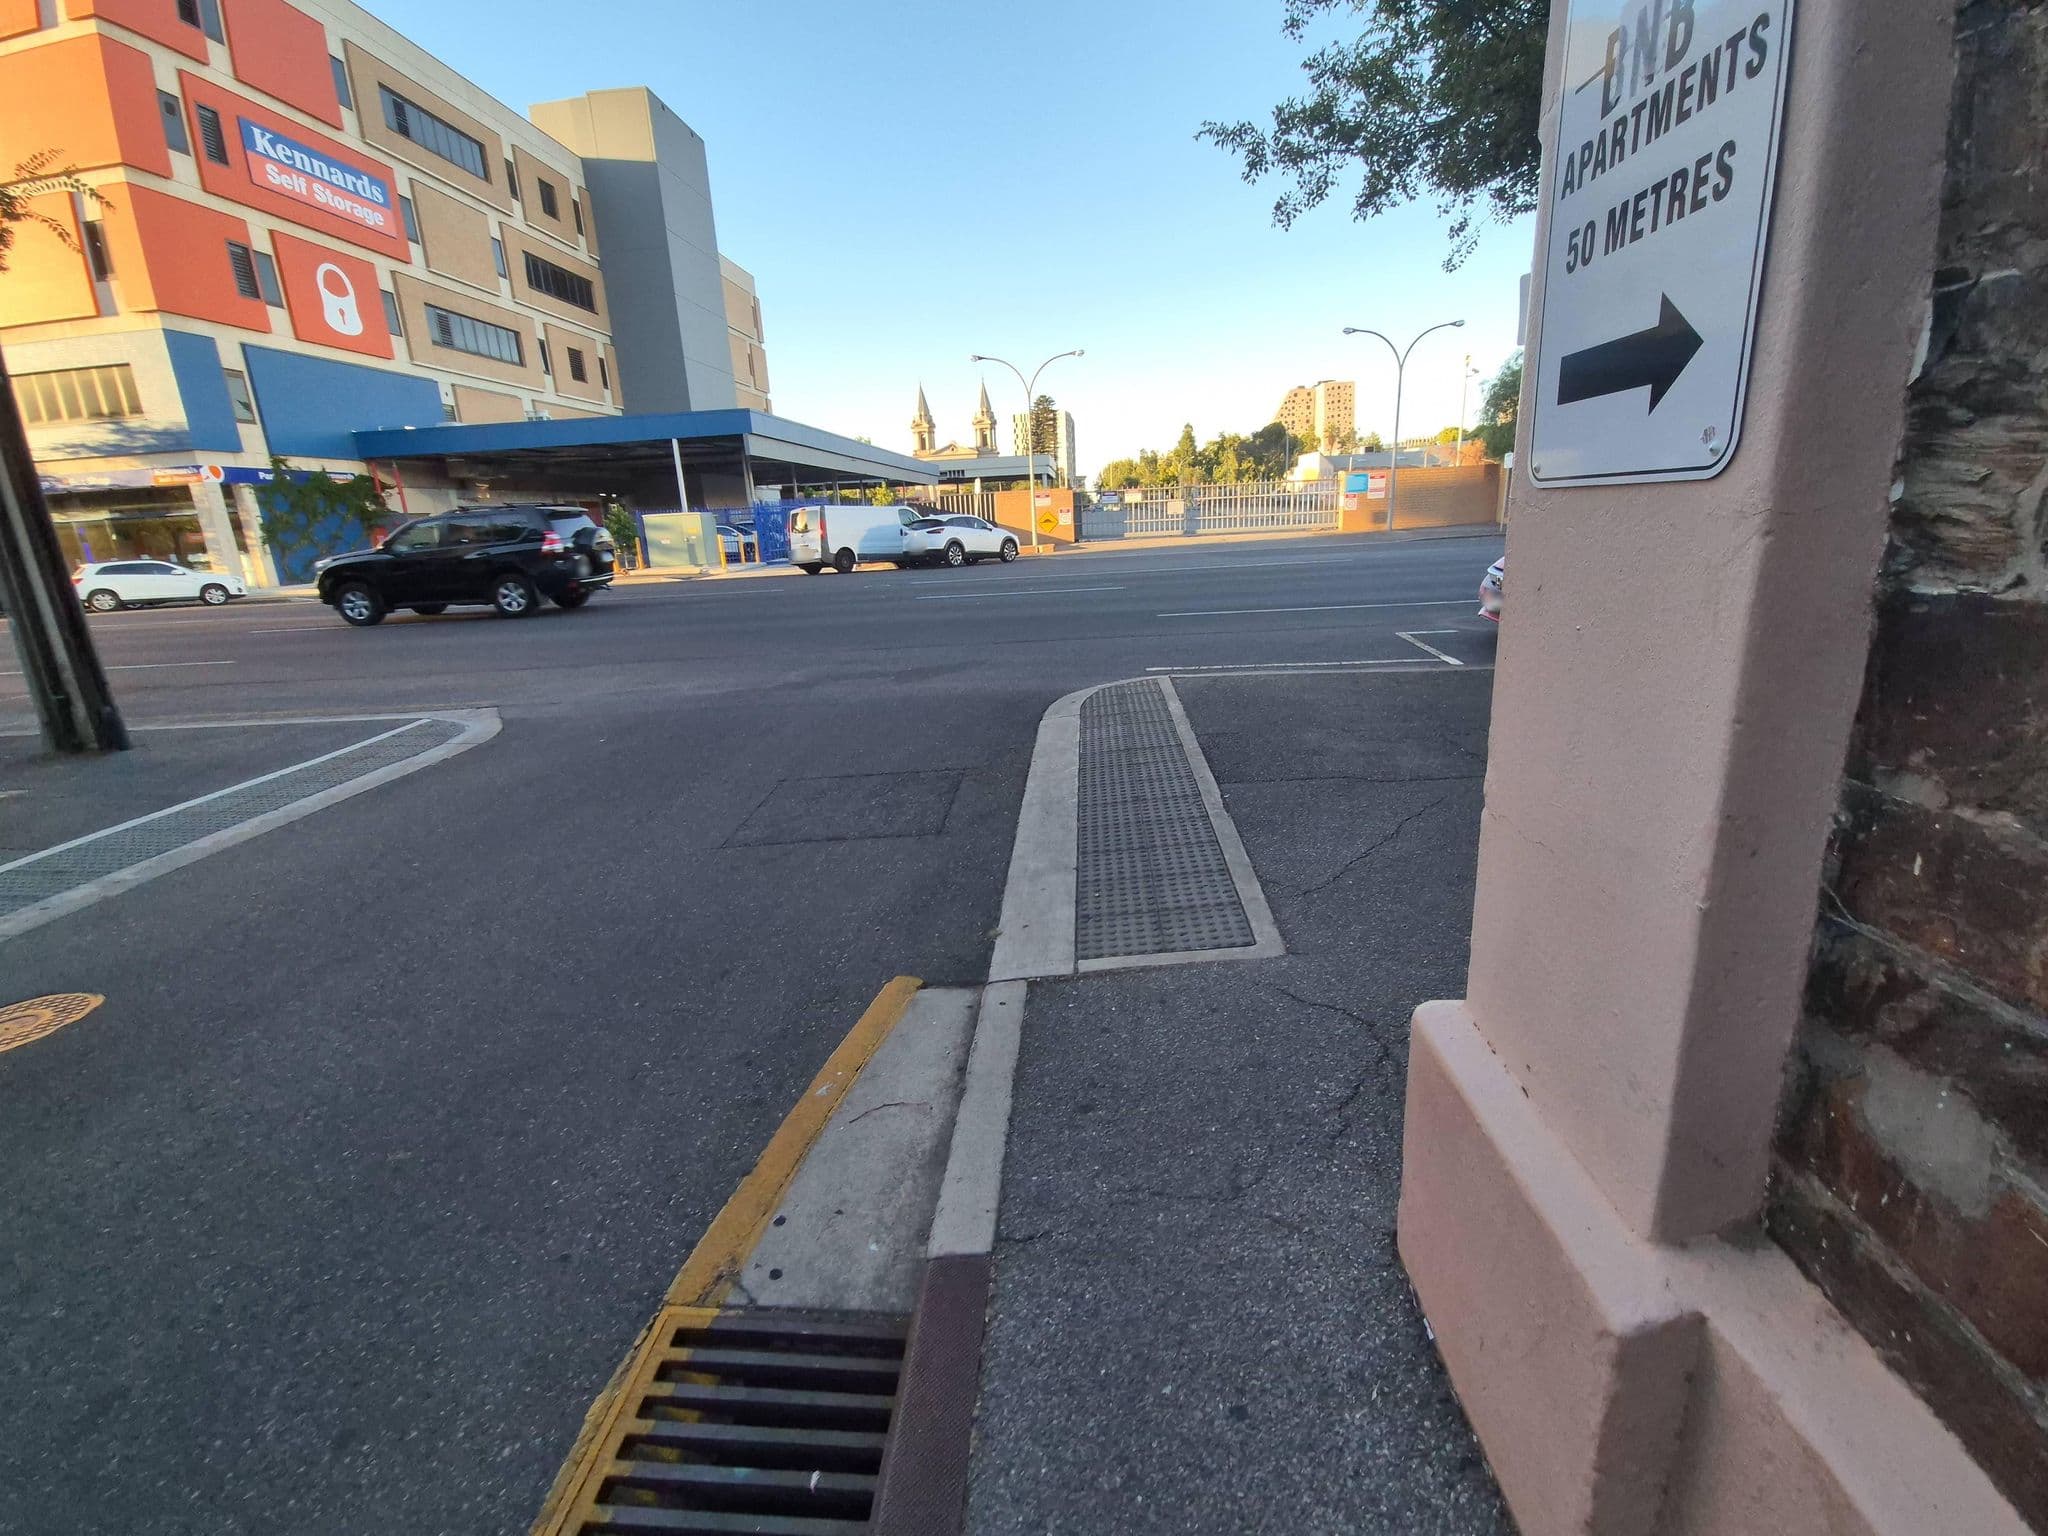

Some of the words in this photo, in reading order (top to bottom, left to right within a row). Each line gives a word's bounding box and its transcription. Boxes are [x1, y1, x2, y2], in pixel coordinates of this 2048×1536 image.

[1561, 12, 1770, 200] APARTMENTS
[251, 126, 384, 204] Kennards
[265, 164, 307, 196] Self
[312, 185, 384, 227] Storage
[1566, 219, 1596, 274] 50
[1604, 140, 1736, 256] METRES
